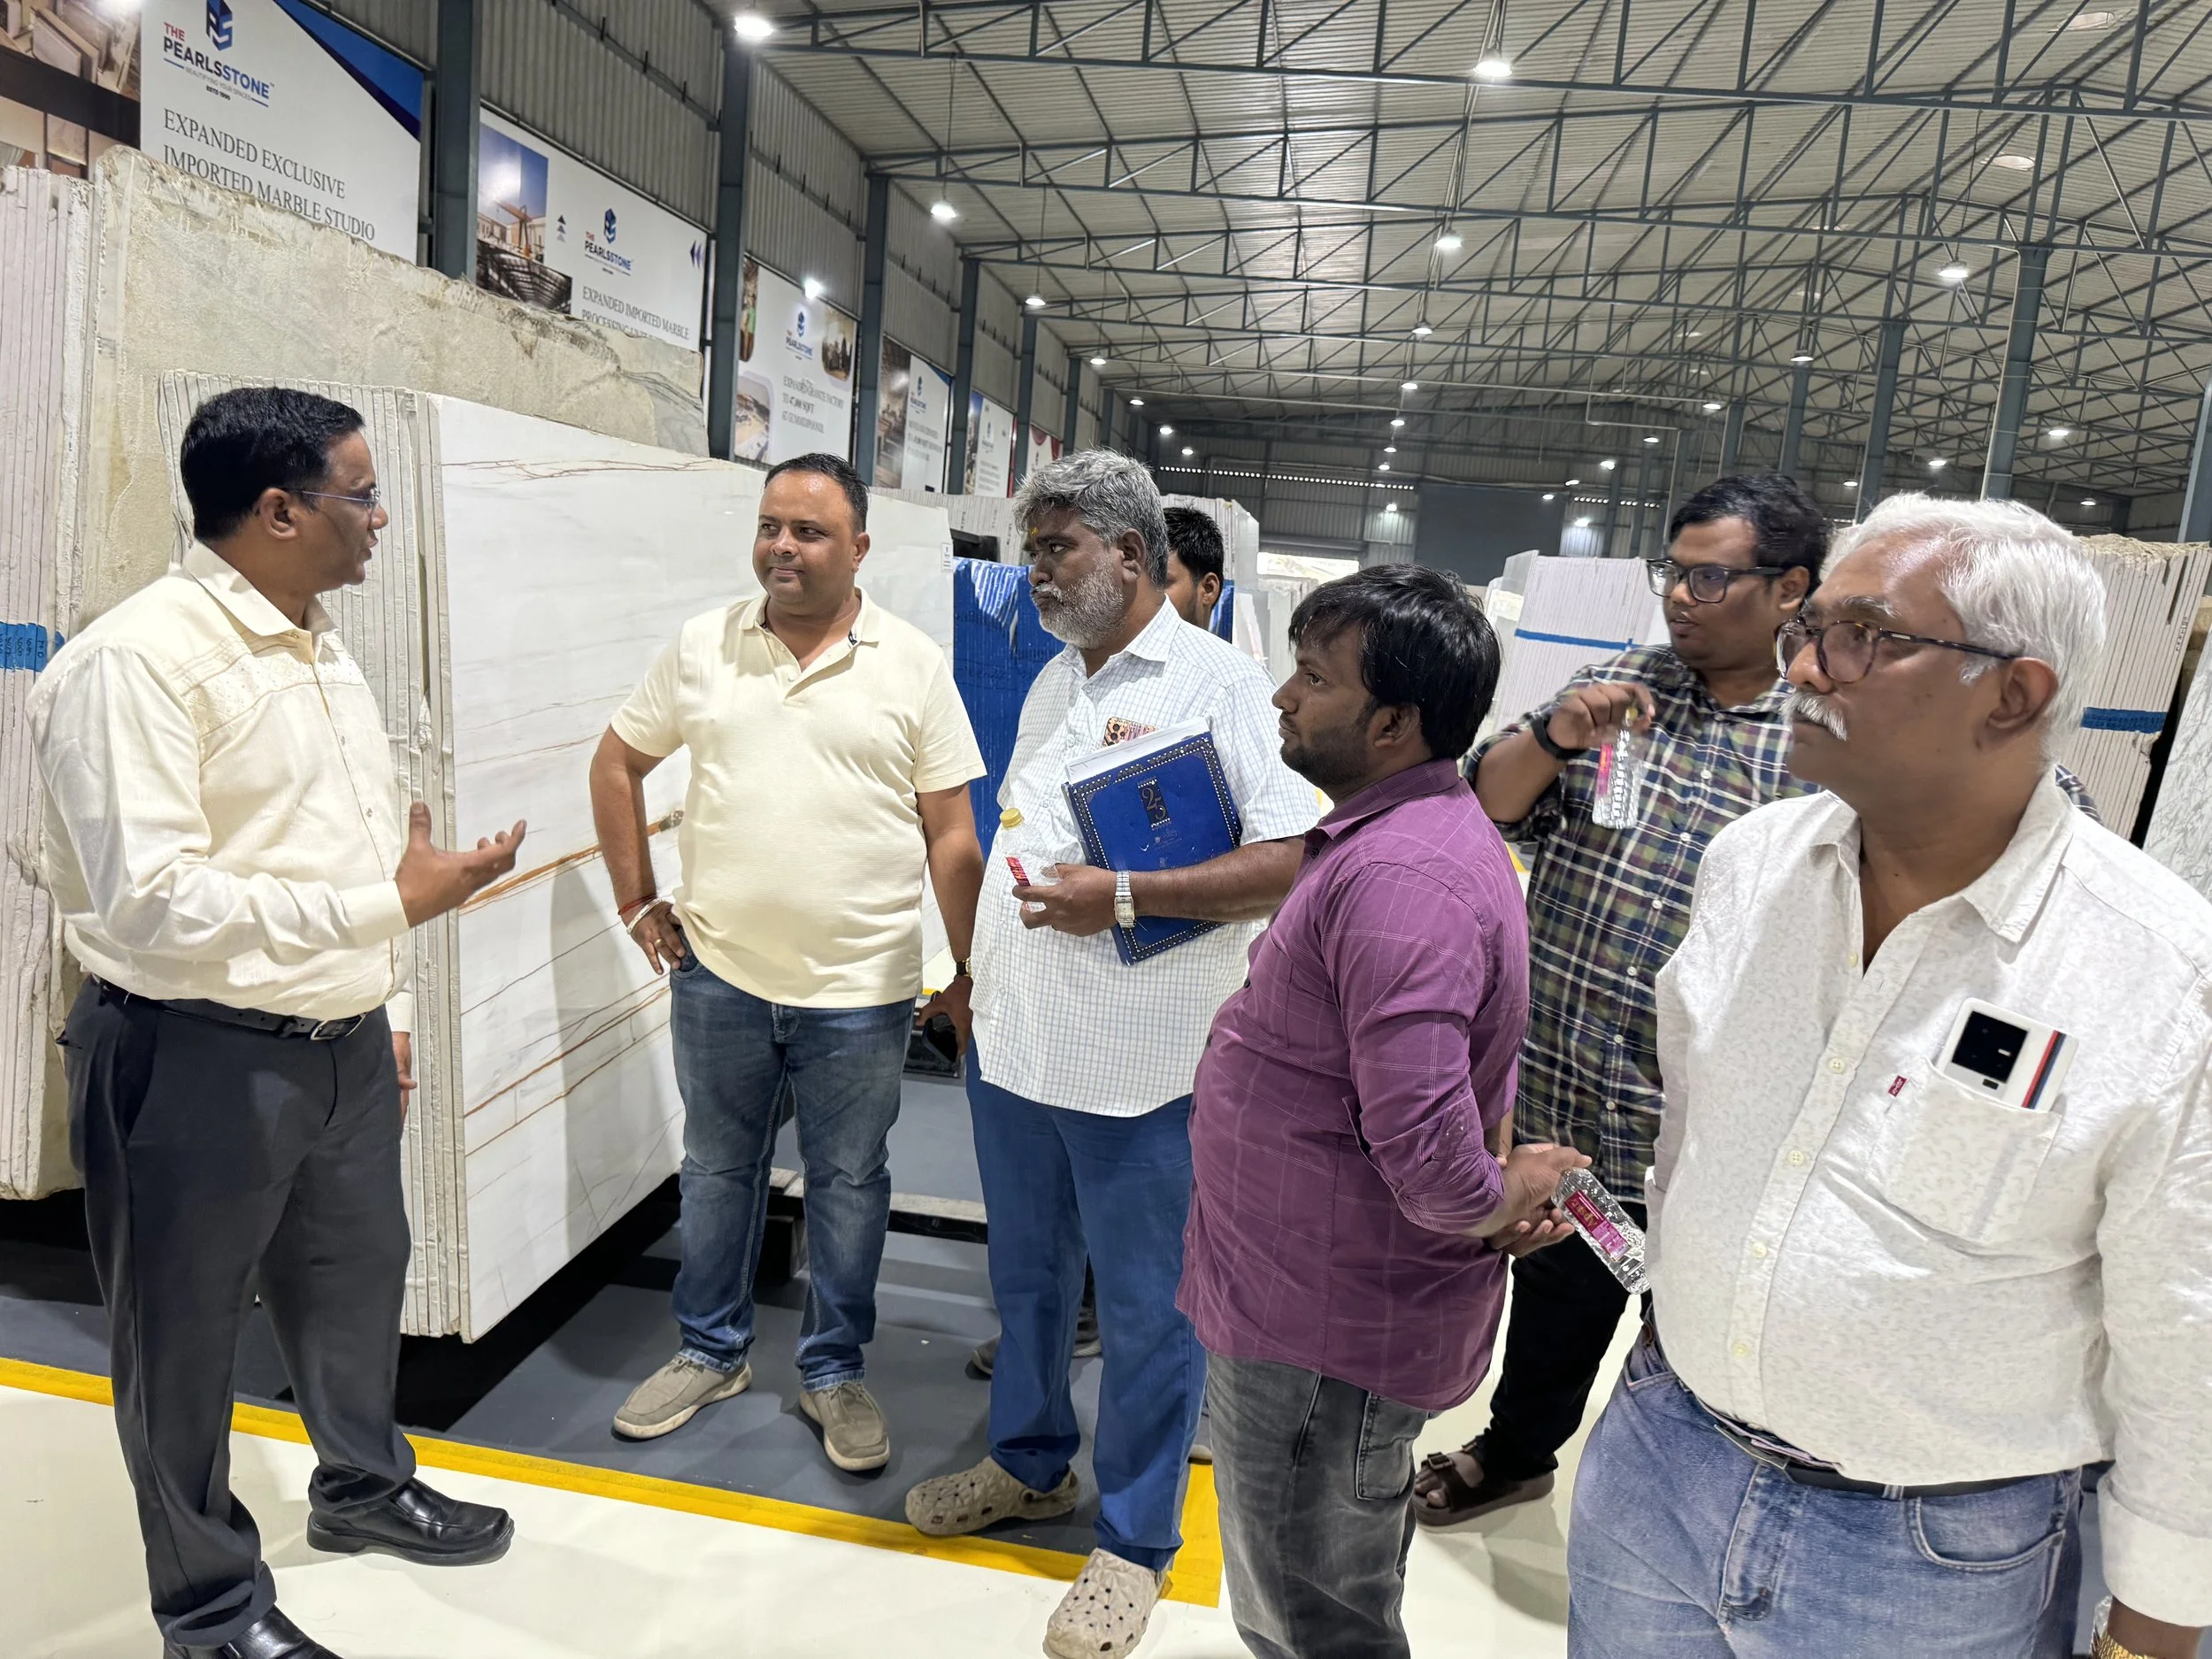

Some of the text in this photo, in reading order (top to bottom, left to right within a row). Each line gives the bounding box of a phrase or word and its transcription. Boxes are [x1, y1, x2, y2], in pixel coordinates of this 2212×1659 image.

[164, 21, 185, 42] THE
[164, 36, 269, 99] PEARLSSTONE
[164, 108, 345, 199] EXPANDED EXCLUSIVE
[164, 144, 375, 241] IMPORTED MARBLE STUDIO
[582, 286, 625, 313] EXPANDED
[626, 303, 661, 329] IMPORTED
[662, 319, 690, 341] MARBLE
